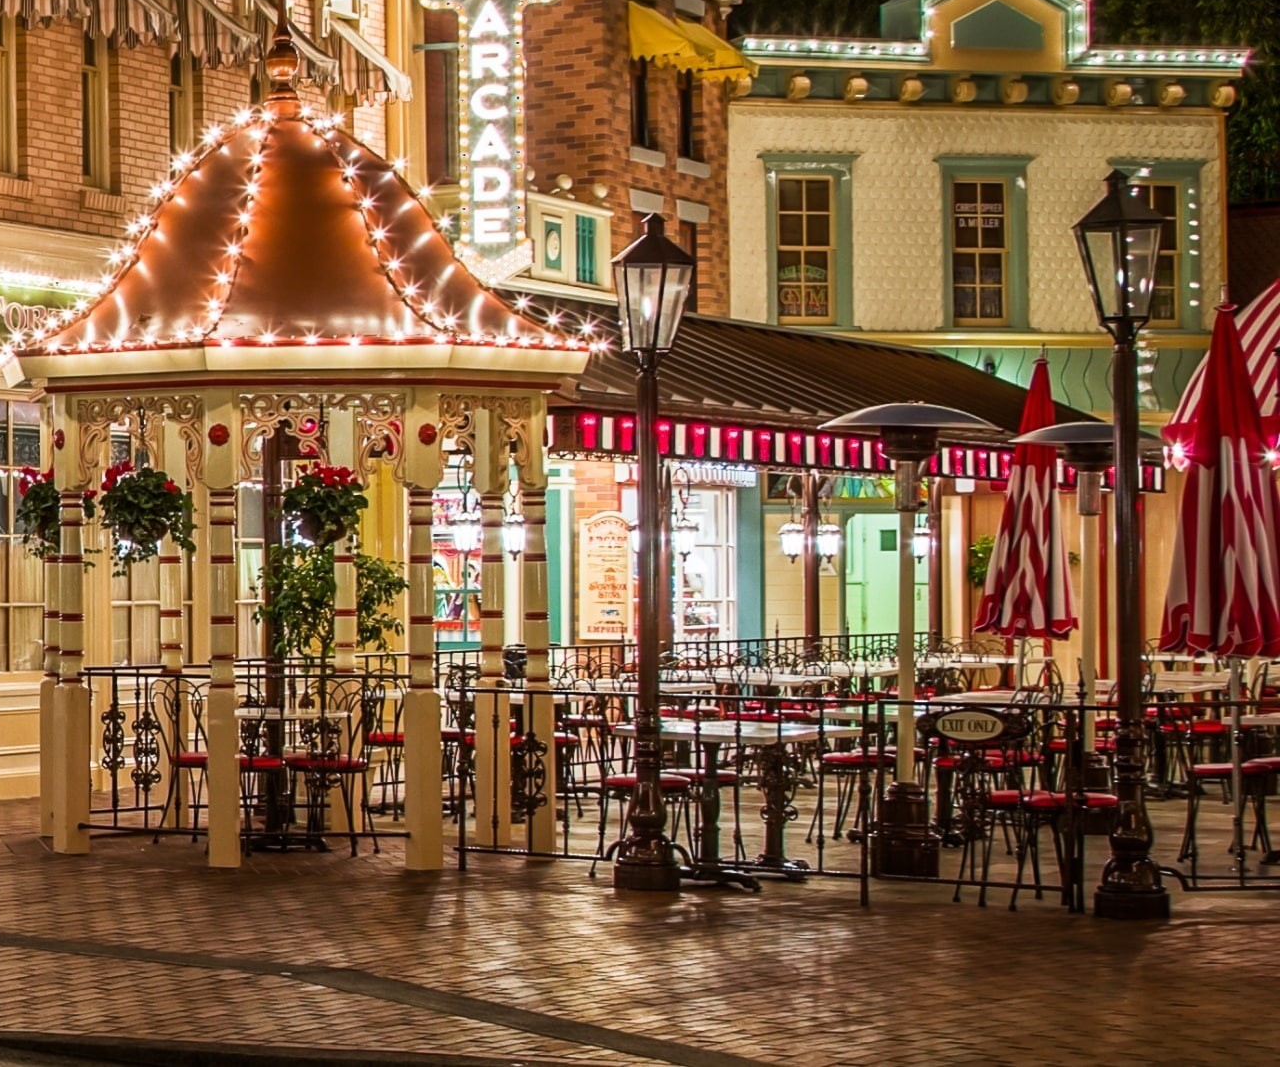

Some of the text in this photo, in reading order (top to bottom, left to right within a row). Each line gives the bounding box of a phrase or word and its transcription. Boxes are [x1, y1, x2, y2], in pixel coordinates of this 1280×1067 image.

[469, 0, 512, 243] ARCADE
[942, 719, 997, 733] EXIT ONLY
